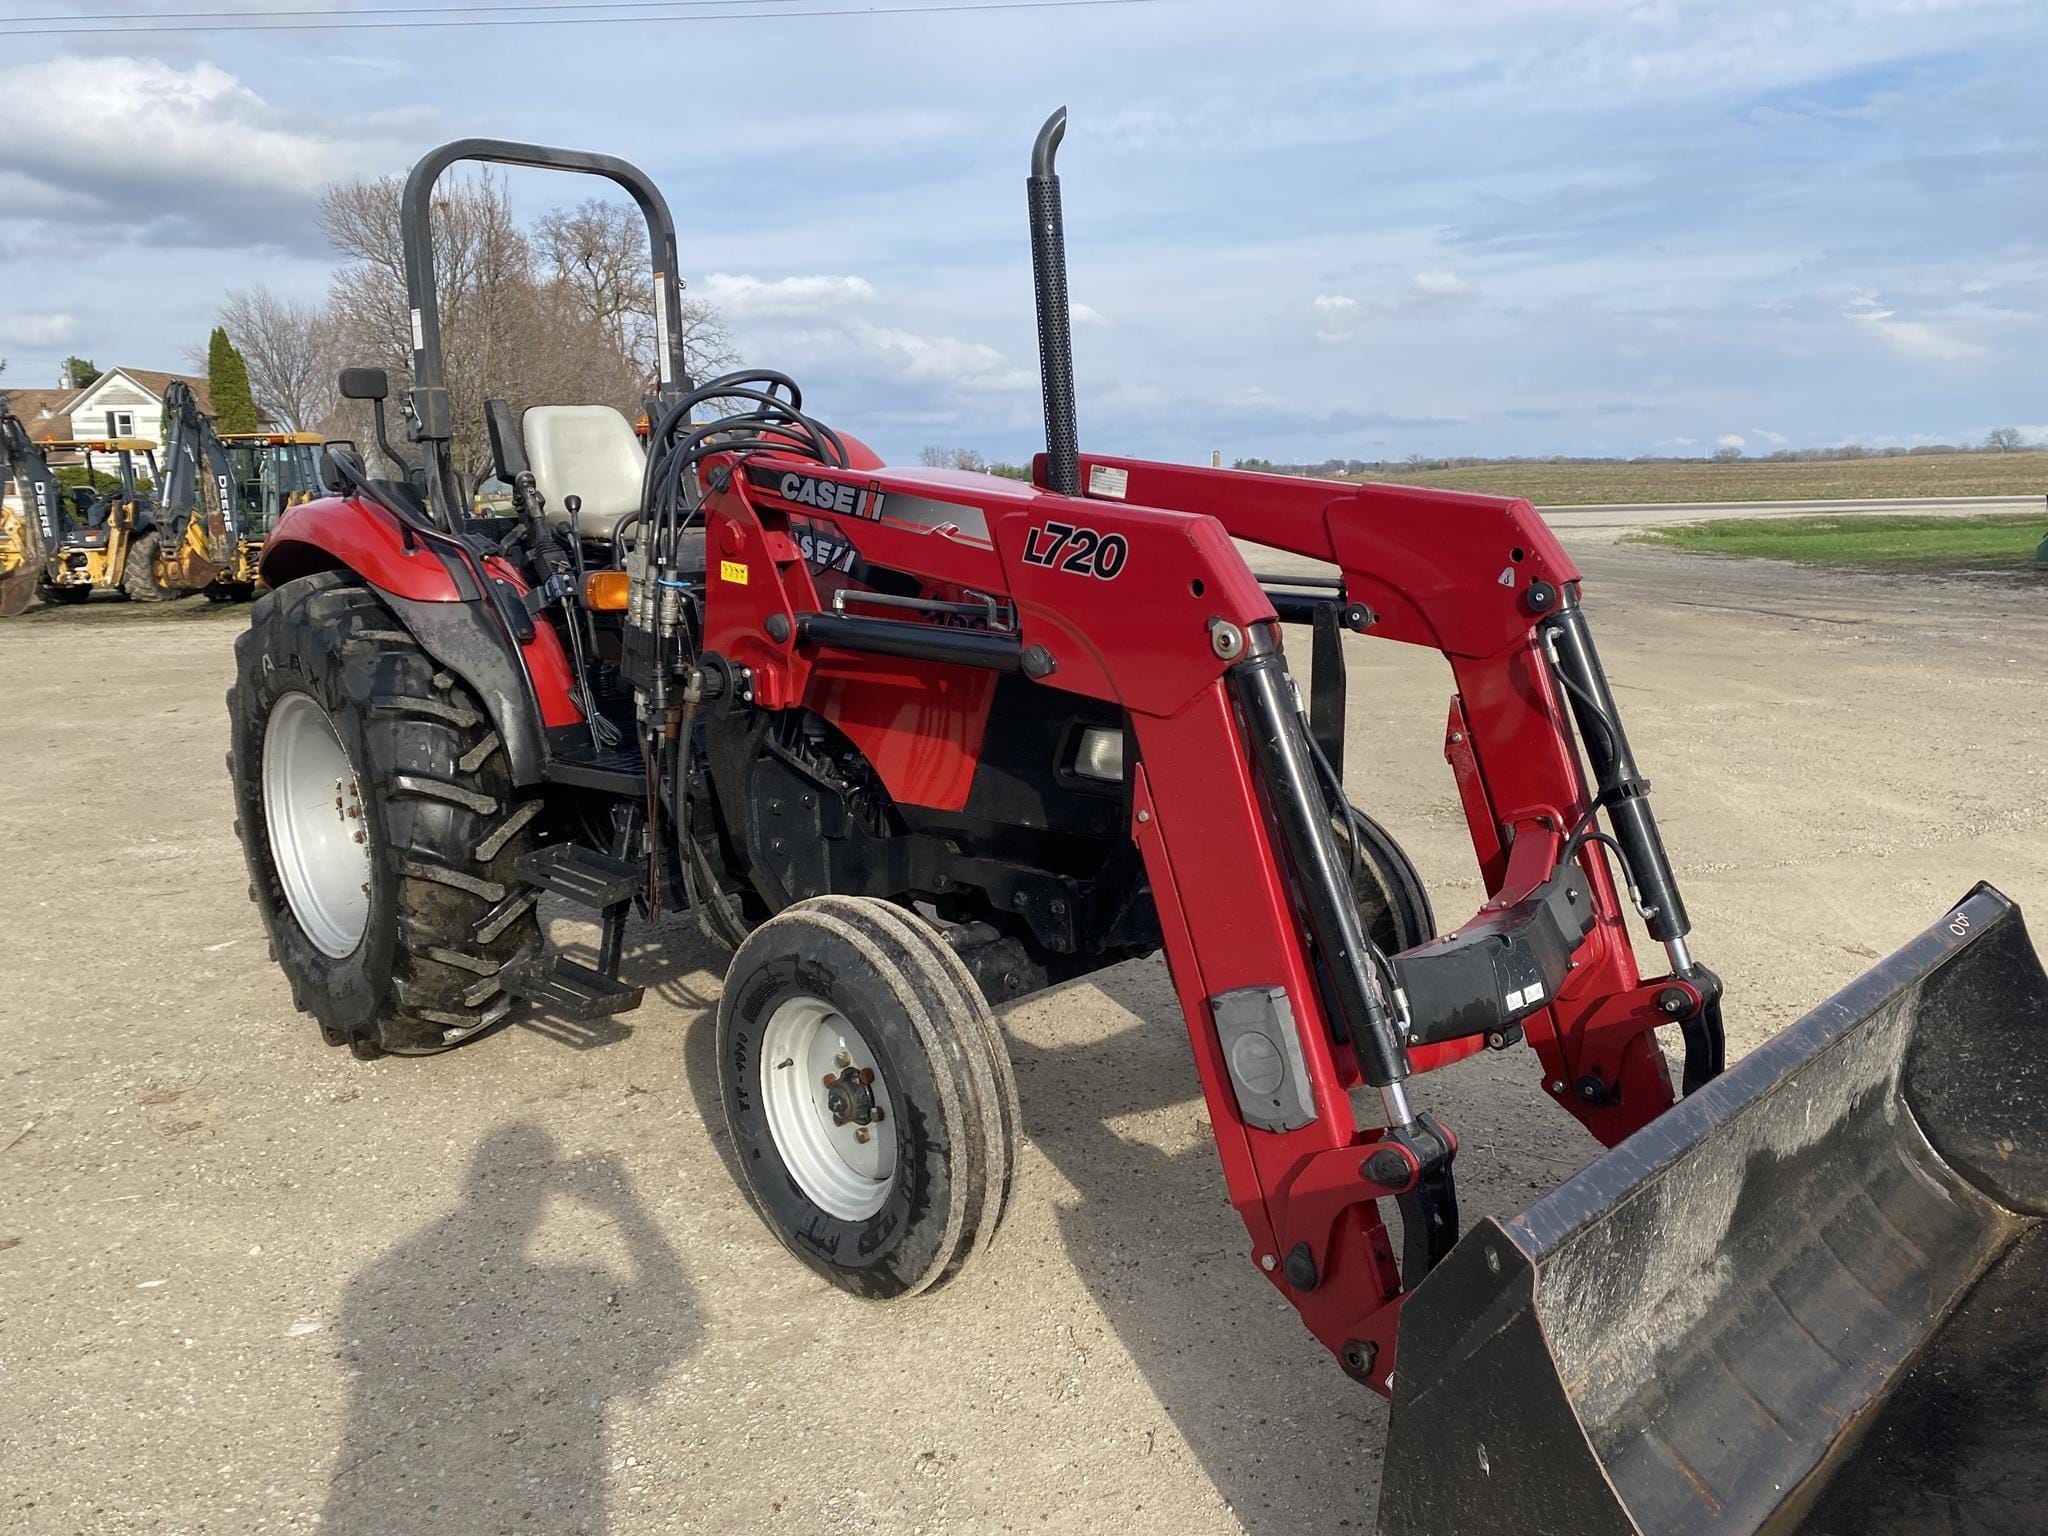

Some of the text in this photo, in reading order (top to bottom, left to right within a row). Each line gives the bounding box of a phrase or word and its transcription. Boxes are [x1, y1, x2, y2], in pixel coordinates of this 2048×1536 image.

[34, 481, 53, 539] DEERE
[217, 474, 233, 533] DEERE
[781, 472, 857, 515] CASE
[1022, 520, 1129, 581] L720
